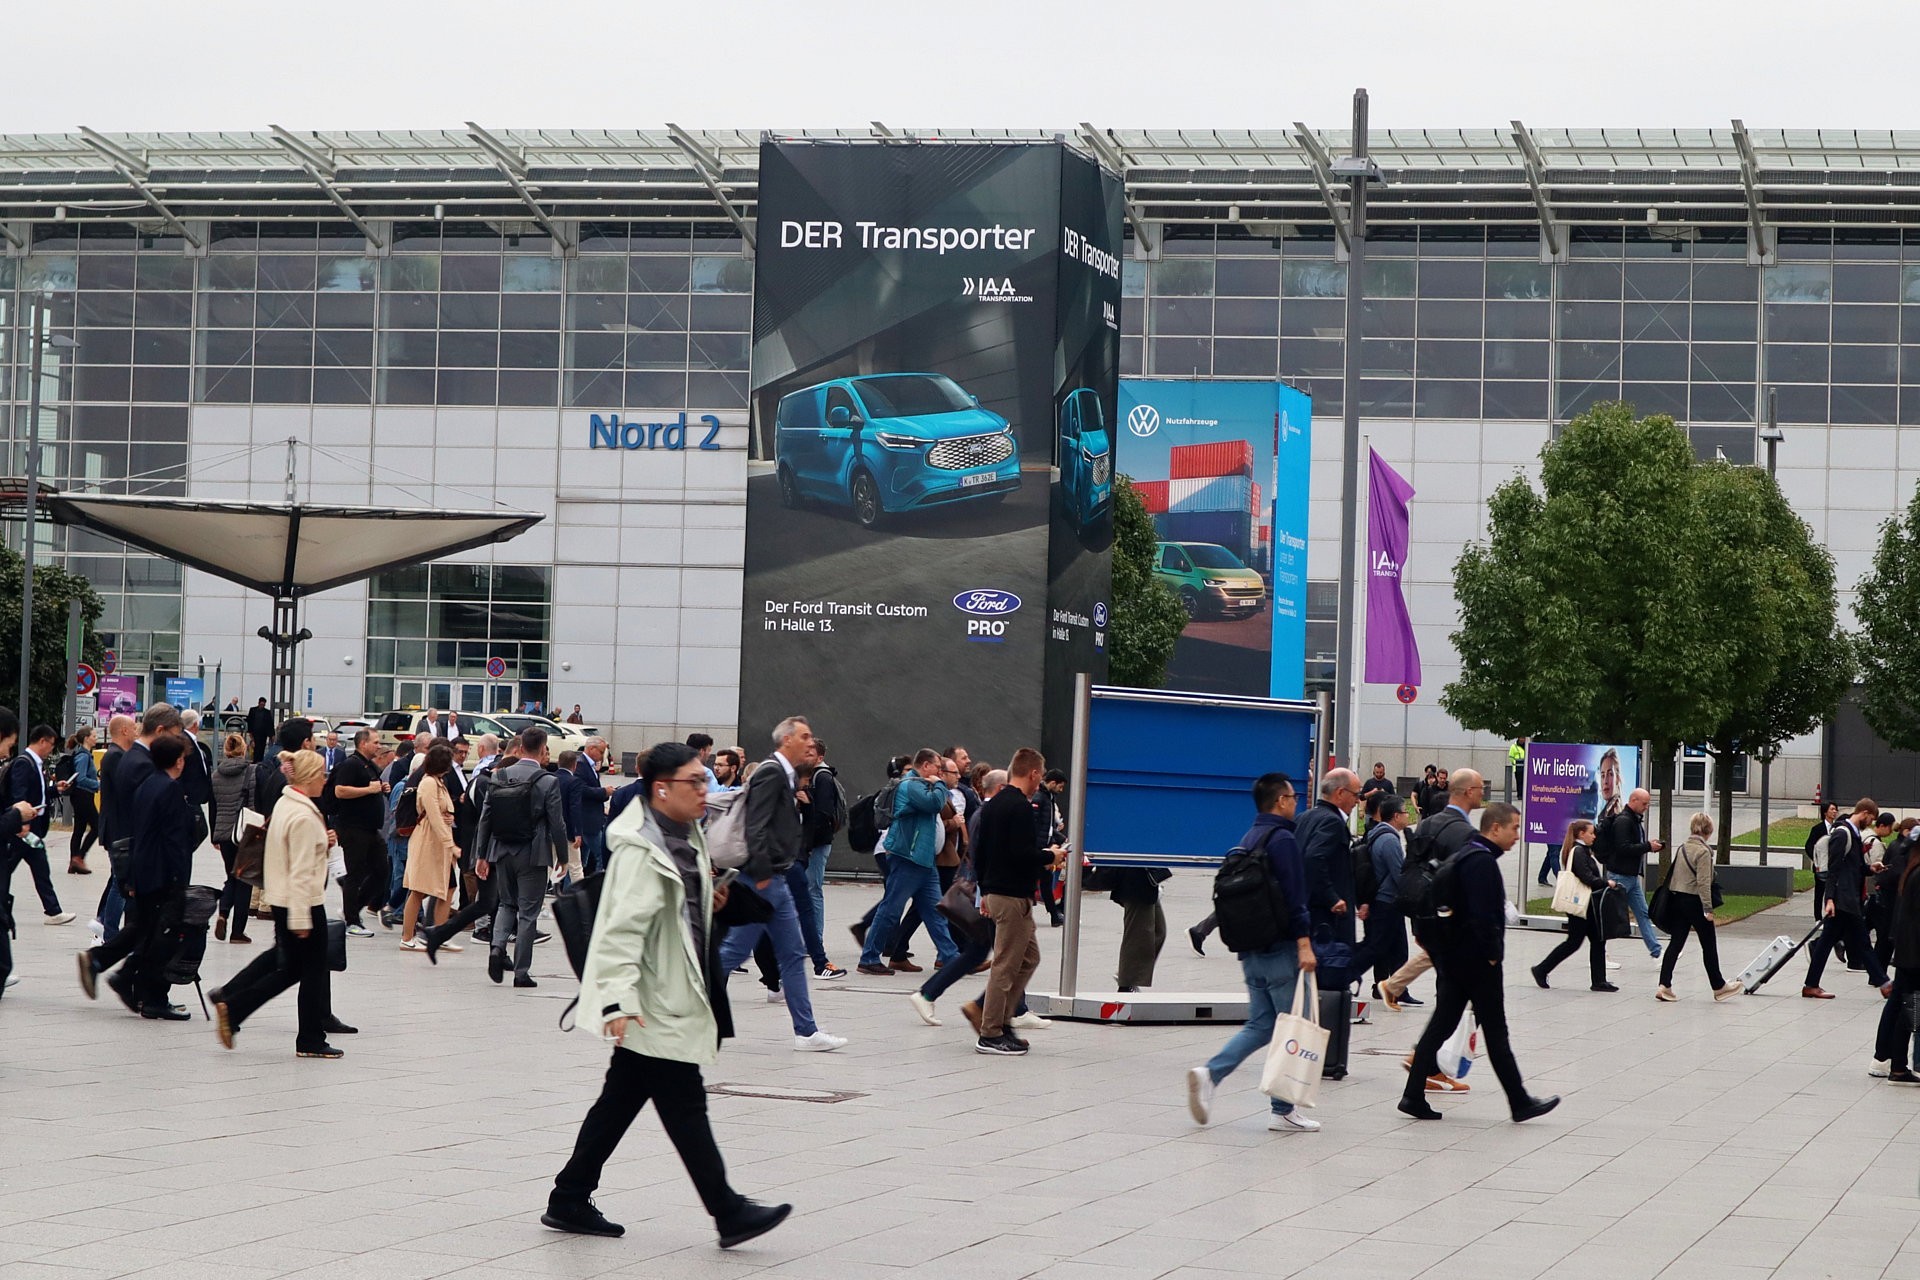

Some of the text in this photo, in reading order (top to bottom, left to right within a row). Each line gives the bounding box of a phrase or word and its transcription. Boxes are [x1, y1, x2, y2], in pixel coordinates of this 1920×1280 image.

[781, 221, 1036, 255] DER Transporter
[1064, 226, 1120, 280] DER Transporter
[979, 278, 1016, 295] IAA
[1166, 418, 1218, 426] Nutzfahrzeuge
[590, 412, 720, 450] Nord 2
[765, 600, 928, 617] Der Ford Transit Custom
[965, 592, 1008, 611] Ford
[764, 618, 835, 632] in Halle 13.
[1532, 758, 1589, 777] Wir liefern.
[1532, 785, 1582, 794] Klimafreundliche Zukunft
[1534, 822, 1544, 831] IAA
